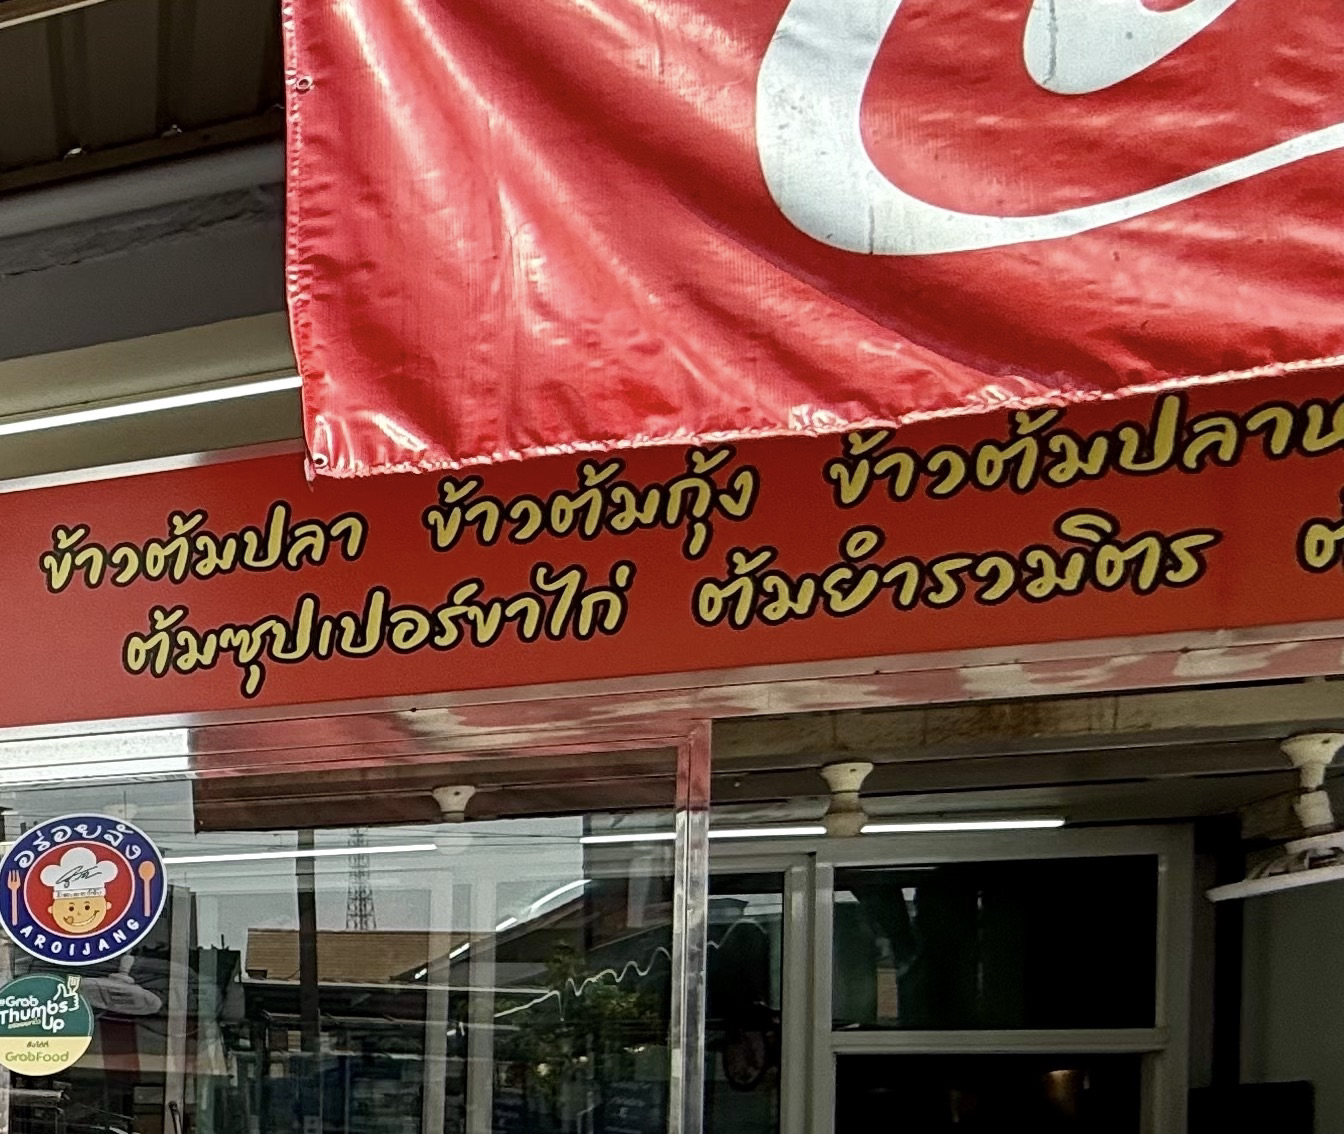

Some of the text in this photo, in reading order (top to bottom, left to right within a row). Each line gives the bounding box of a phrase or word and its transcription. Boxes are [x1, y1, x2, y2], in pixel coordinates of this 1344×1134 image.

[41, 502, 366, 591] ข้าวต้มปลา
[426, 448, 755, 557] ข้าวต้มกุ้ง
[125, 564, 632, 695] ต้มซุปเปอร์ขาไก่
[19, 918, 141, 957] AROIJANG
[41, 1015, 66, 1034] Up
[5, 1051, 70, 1063] GrabFood
